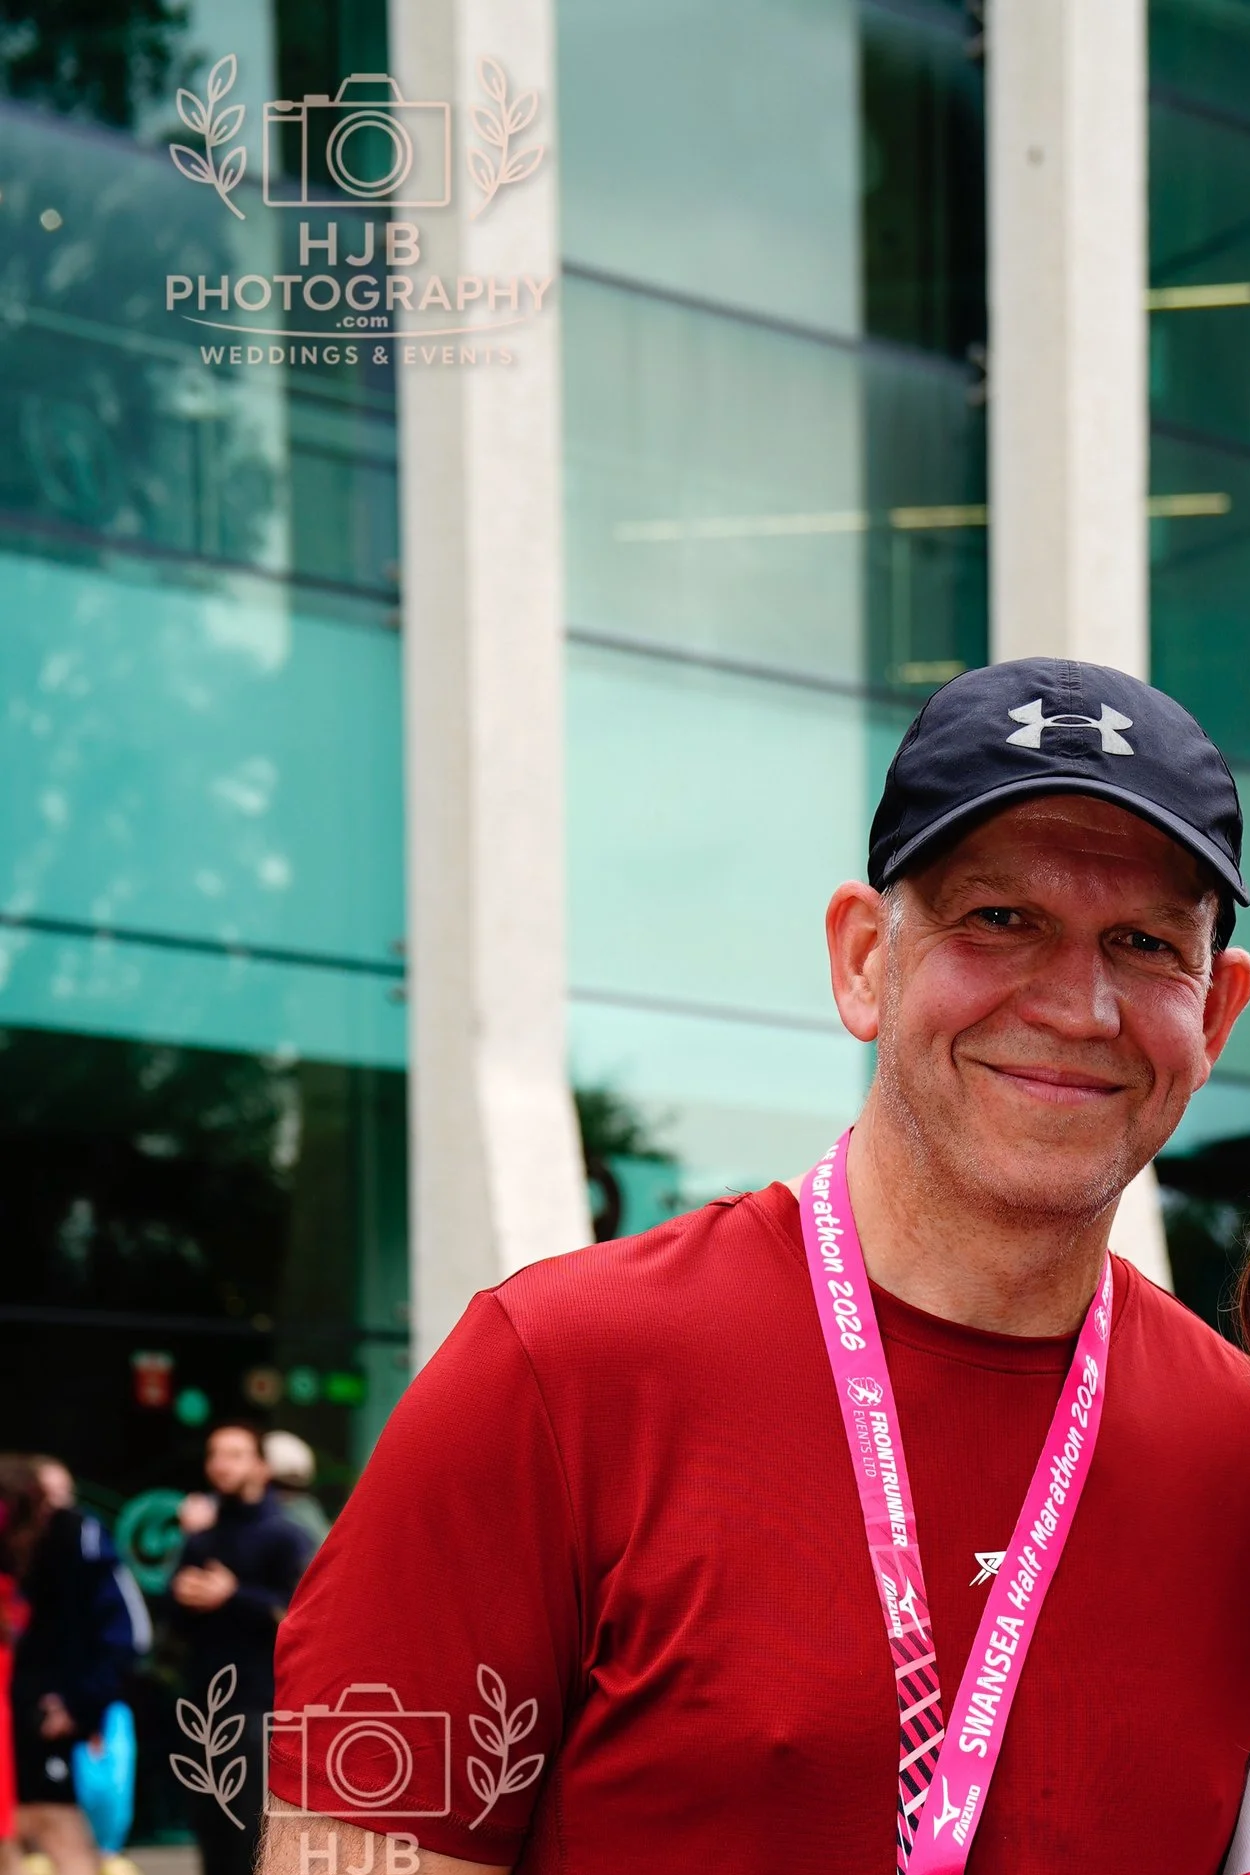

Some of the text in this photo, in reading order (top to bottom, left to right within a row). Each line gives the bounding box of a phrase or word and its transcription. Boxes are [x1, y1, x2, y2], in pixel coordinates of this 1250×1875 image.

[811, 1163, 844, 1274] Marathon
[827, 1279, 867, 1351] 2026
[852, 1409, 877, 1478] EVENTS LTD
[869, 1411, 907, 1547] FRONTRUNNER
[959, 1354, 1099, 1759] SWANSEA Half Marathon 2026
